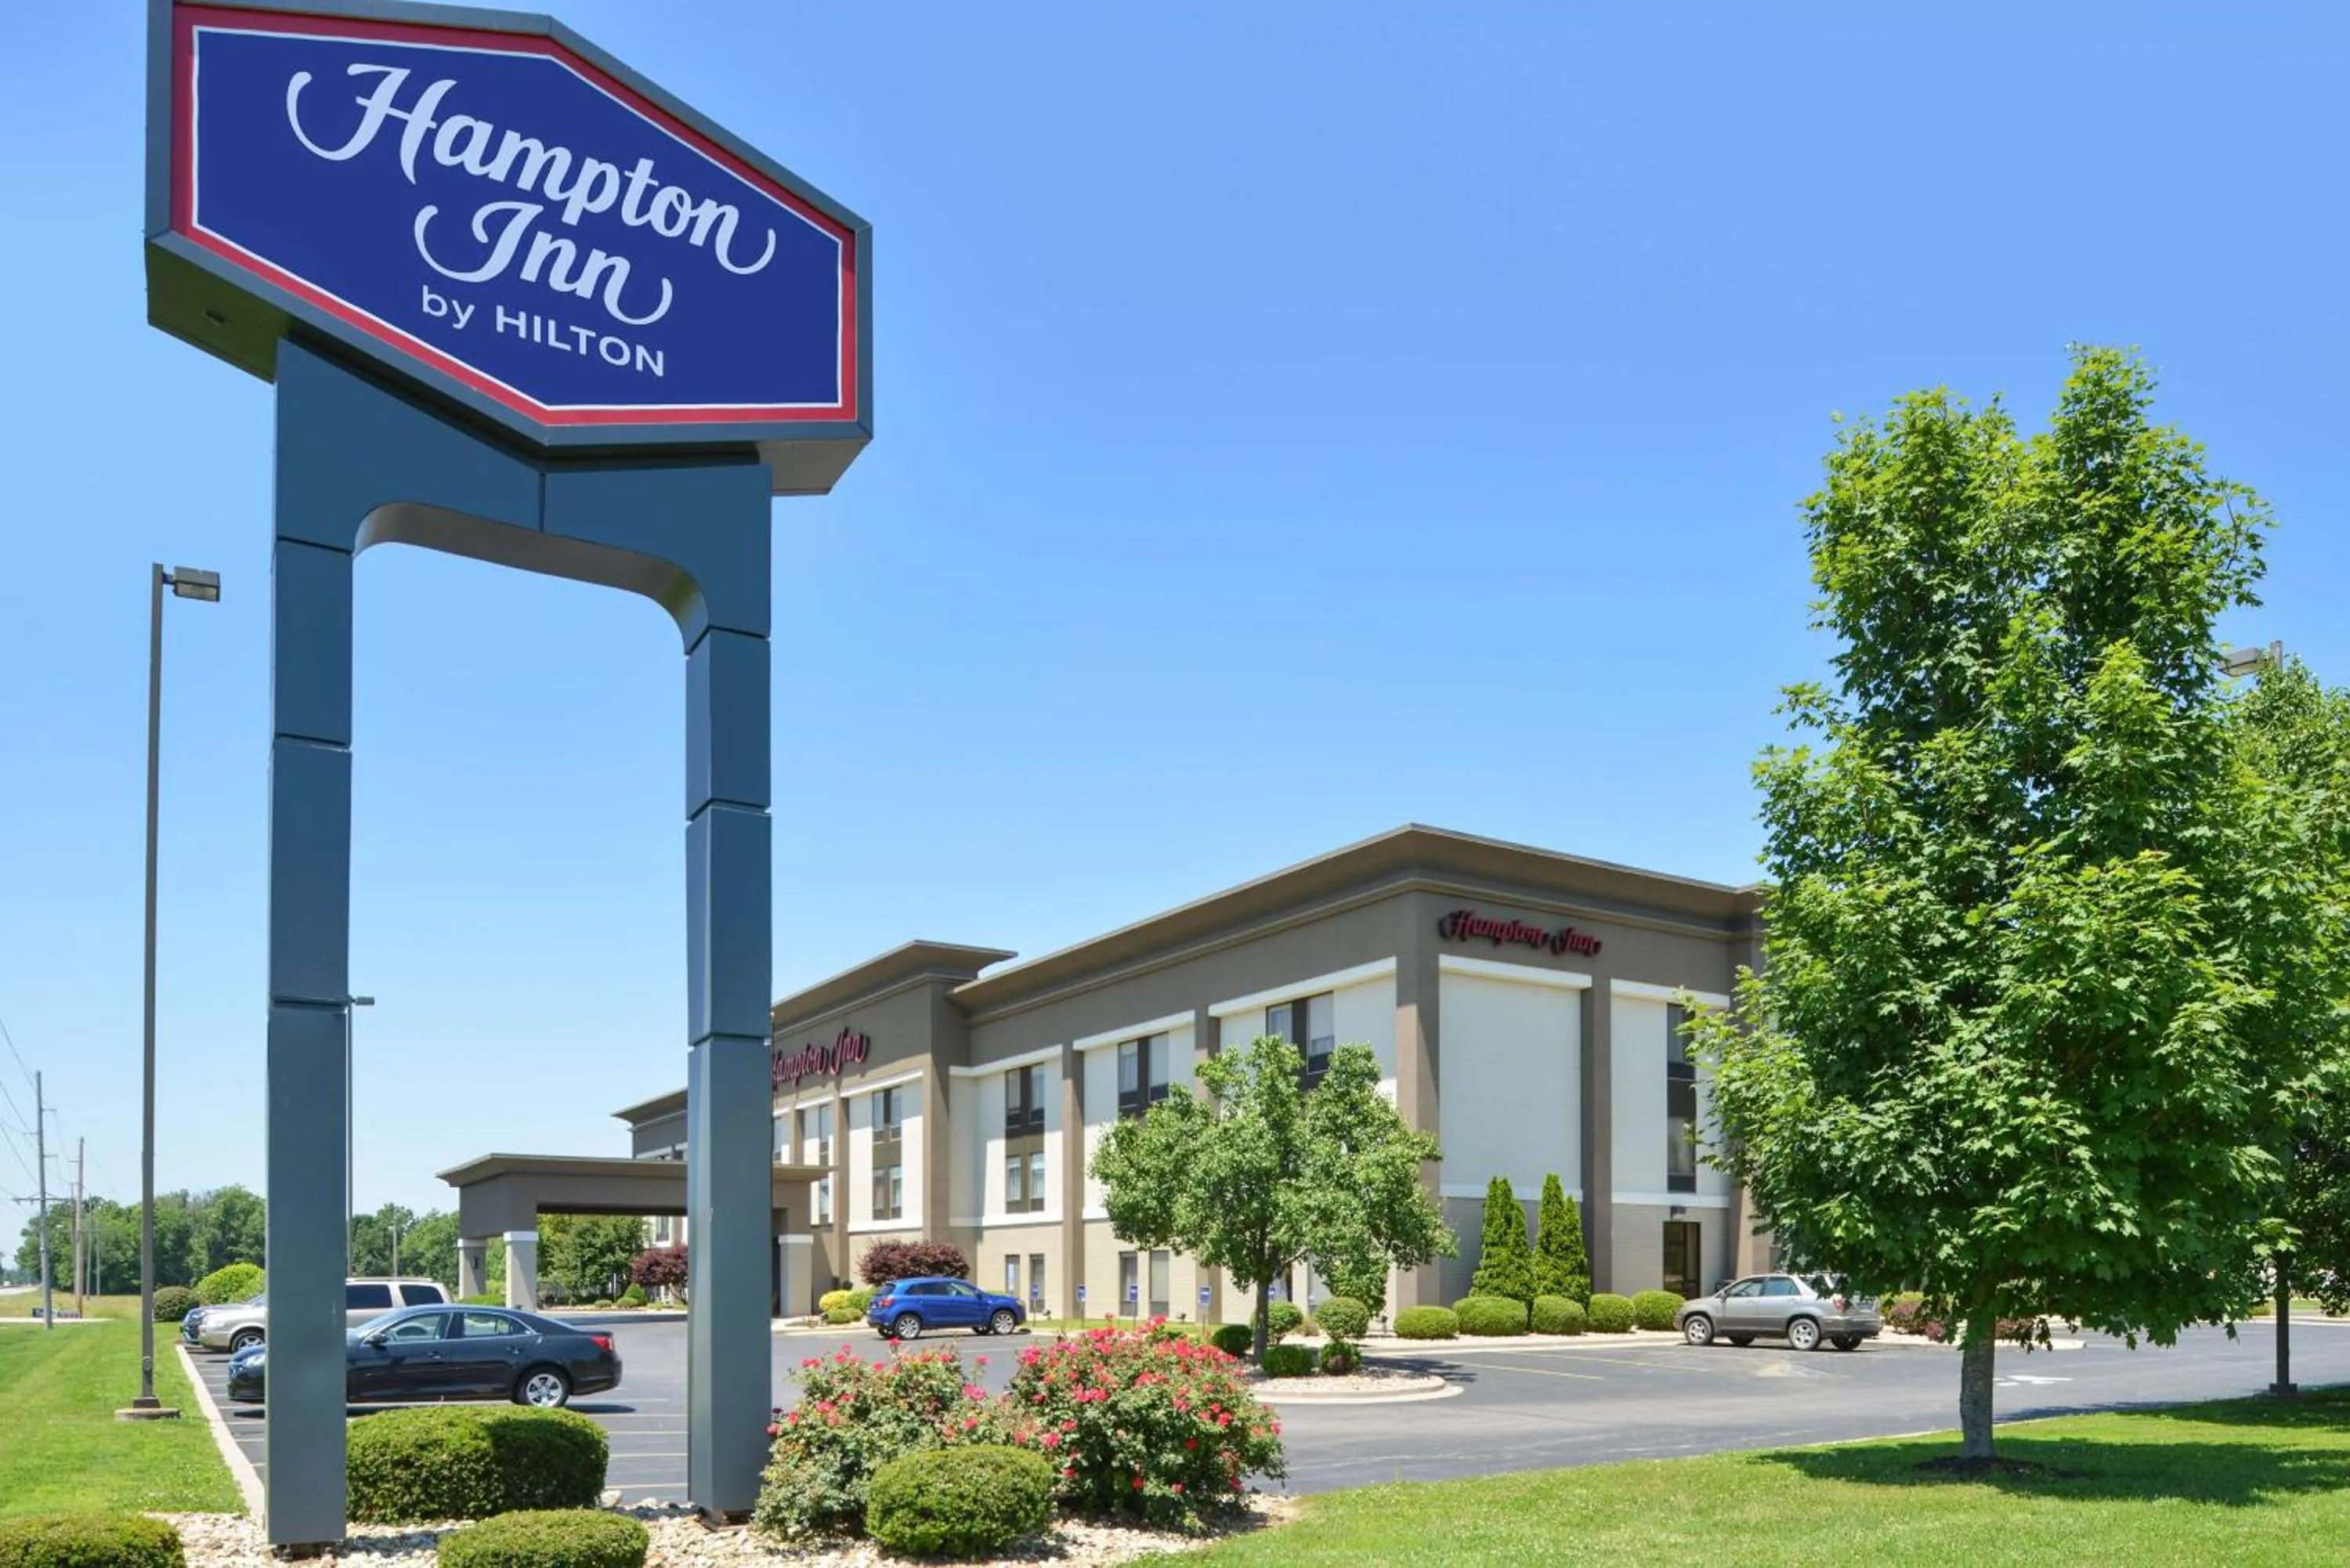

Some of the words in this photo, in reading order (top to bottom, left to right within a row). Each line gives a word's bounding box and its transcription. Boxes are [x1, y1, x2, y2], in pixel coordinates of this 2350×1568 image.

[287, 63, 776, 275] Hampton
[414, 201, 673, 325] Inn
[422, 285, 475, 329] by
[496, 305, 663, 377] HILTON
[1438, 909, 1550, 948] Hampton
[1549, 925, 1602, 957] Inn
[830, 1027, 870, 1075] Inn
